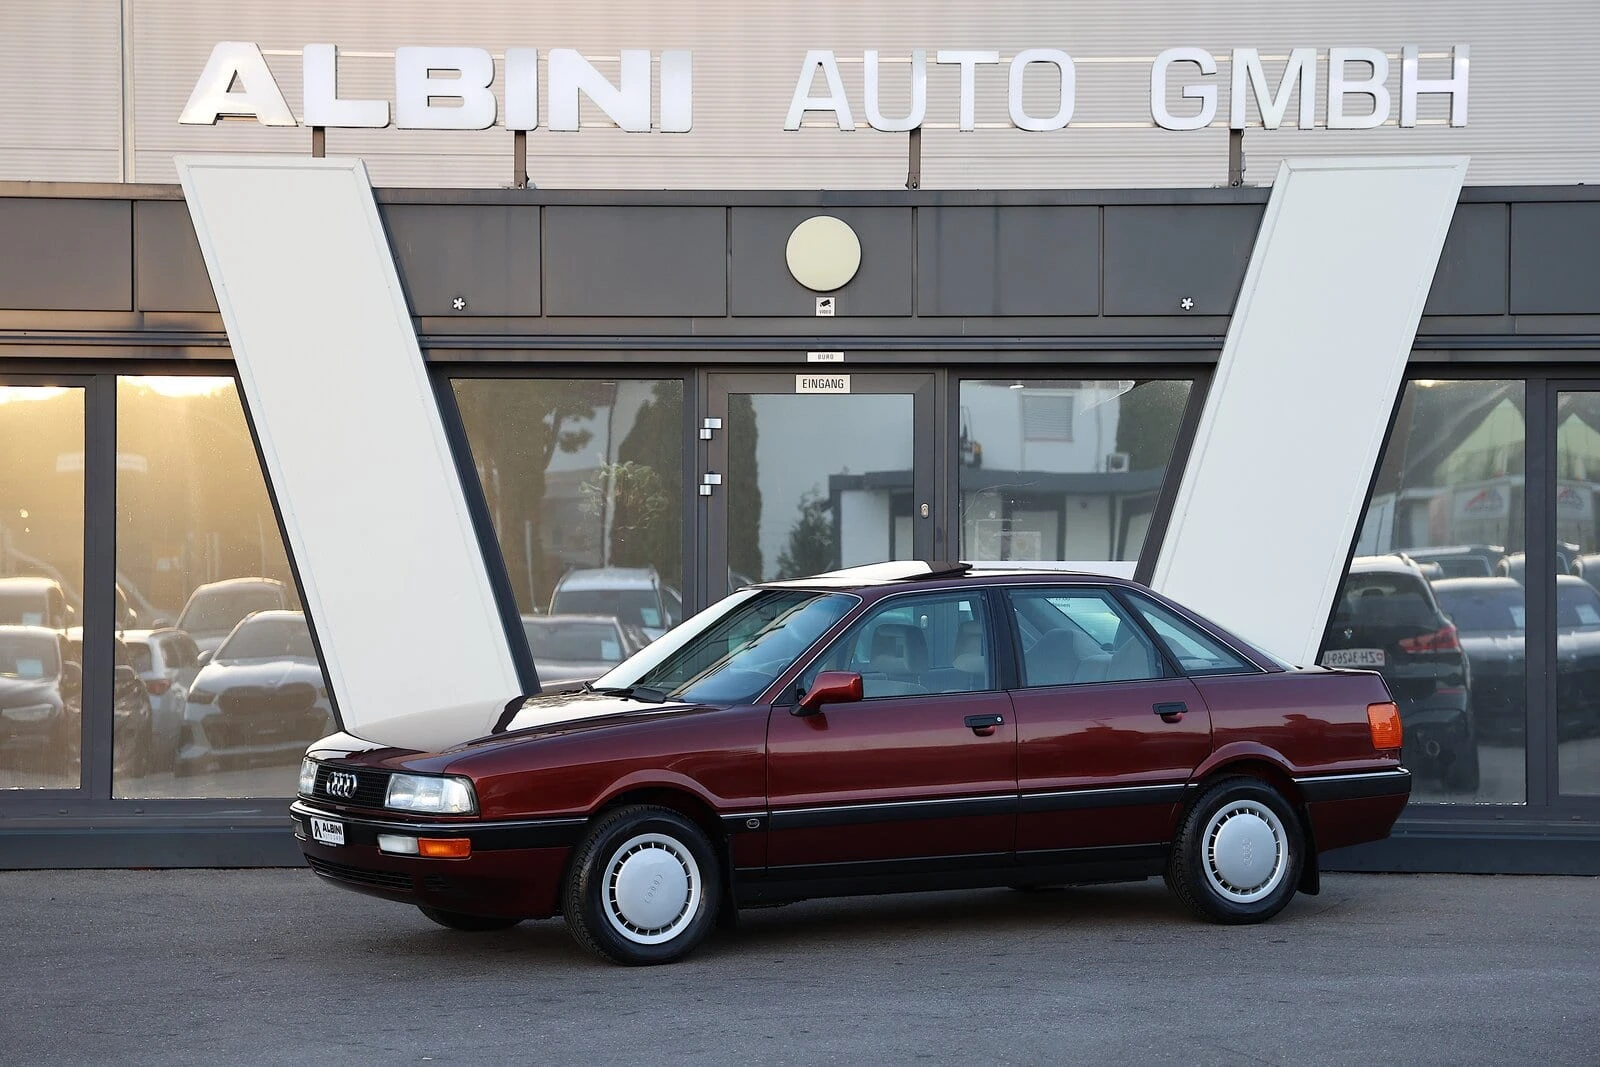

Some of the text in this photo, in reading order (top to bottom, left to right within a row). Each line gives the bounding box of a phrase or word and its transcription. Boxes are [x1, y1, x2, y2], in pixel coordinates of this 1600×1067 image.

[178, 41, 1470, 134] ALBINI AUTO GMBH
[802, 378, 844, 389] EINGANG
